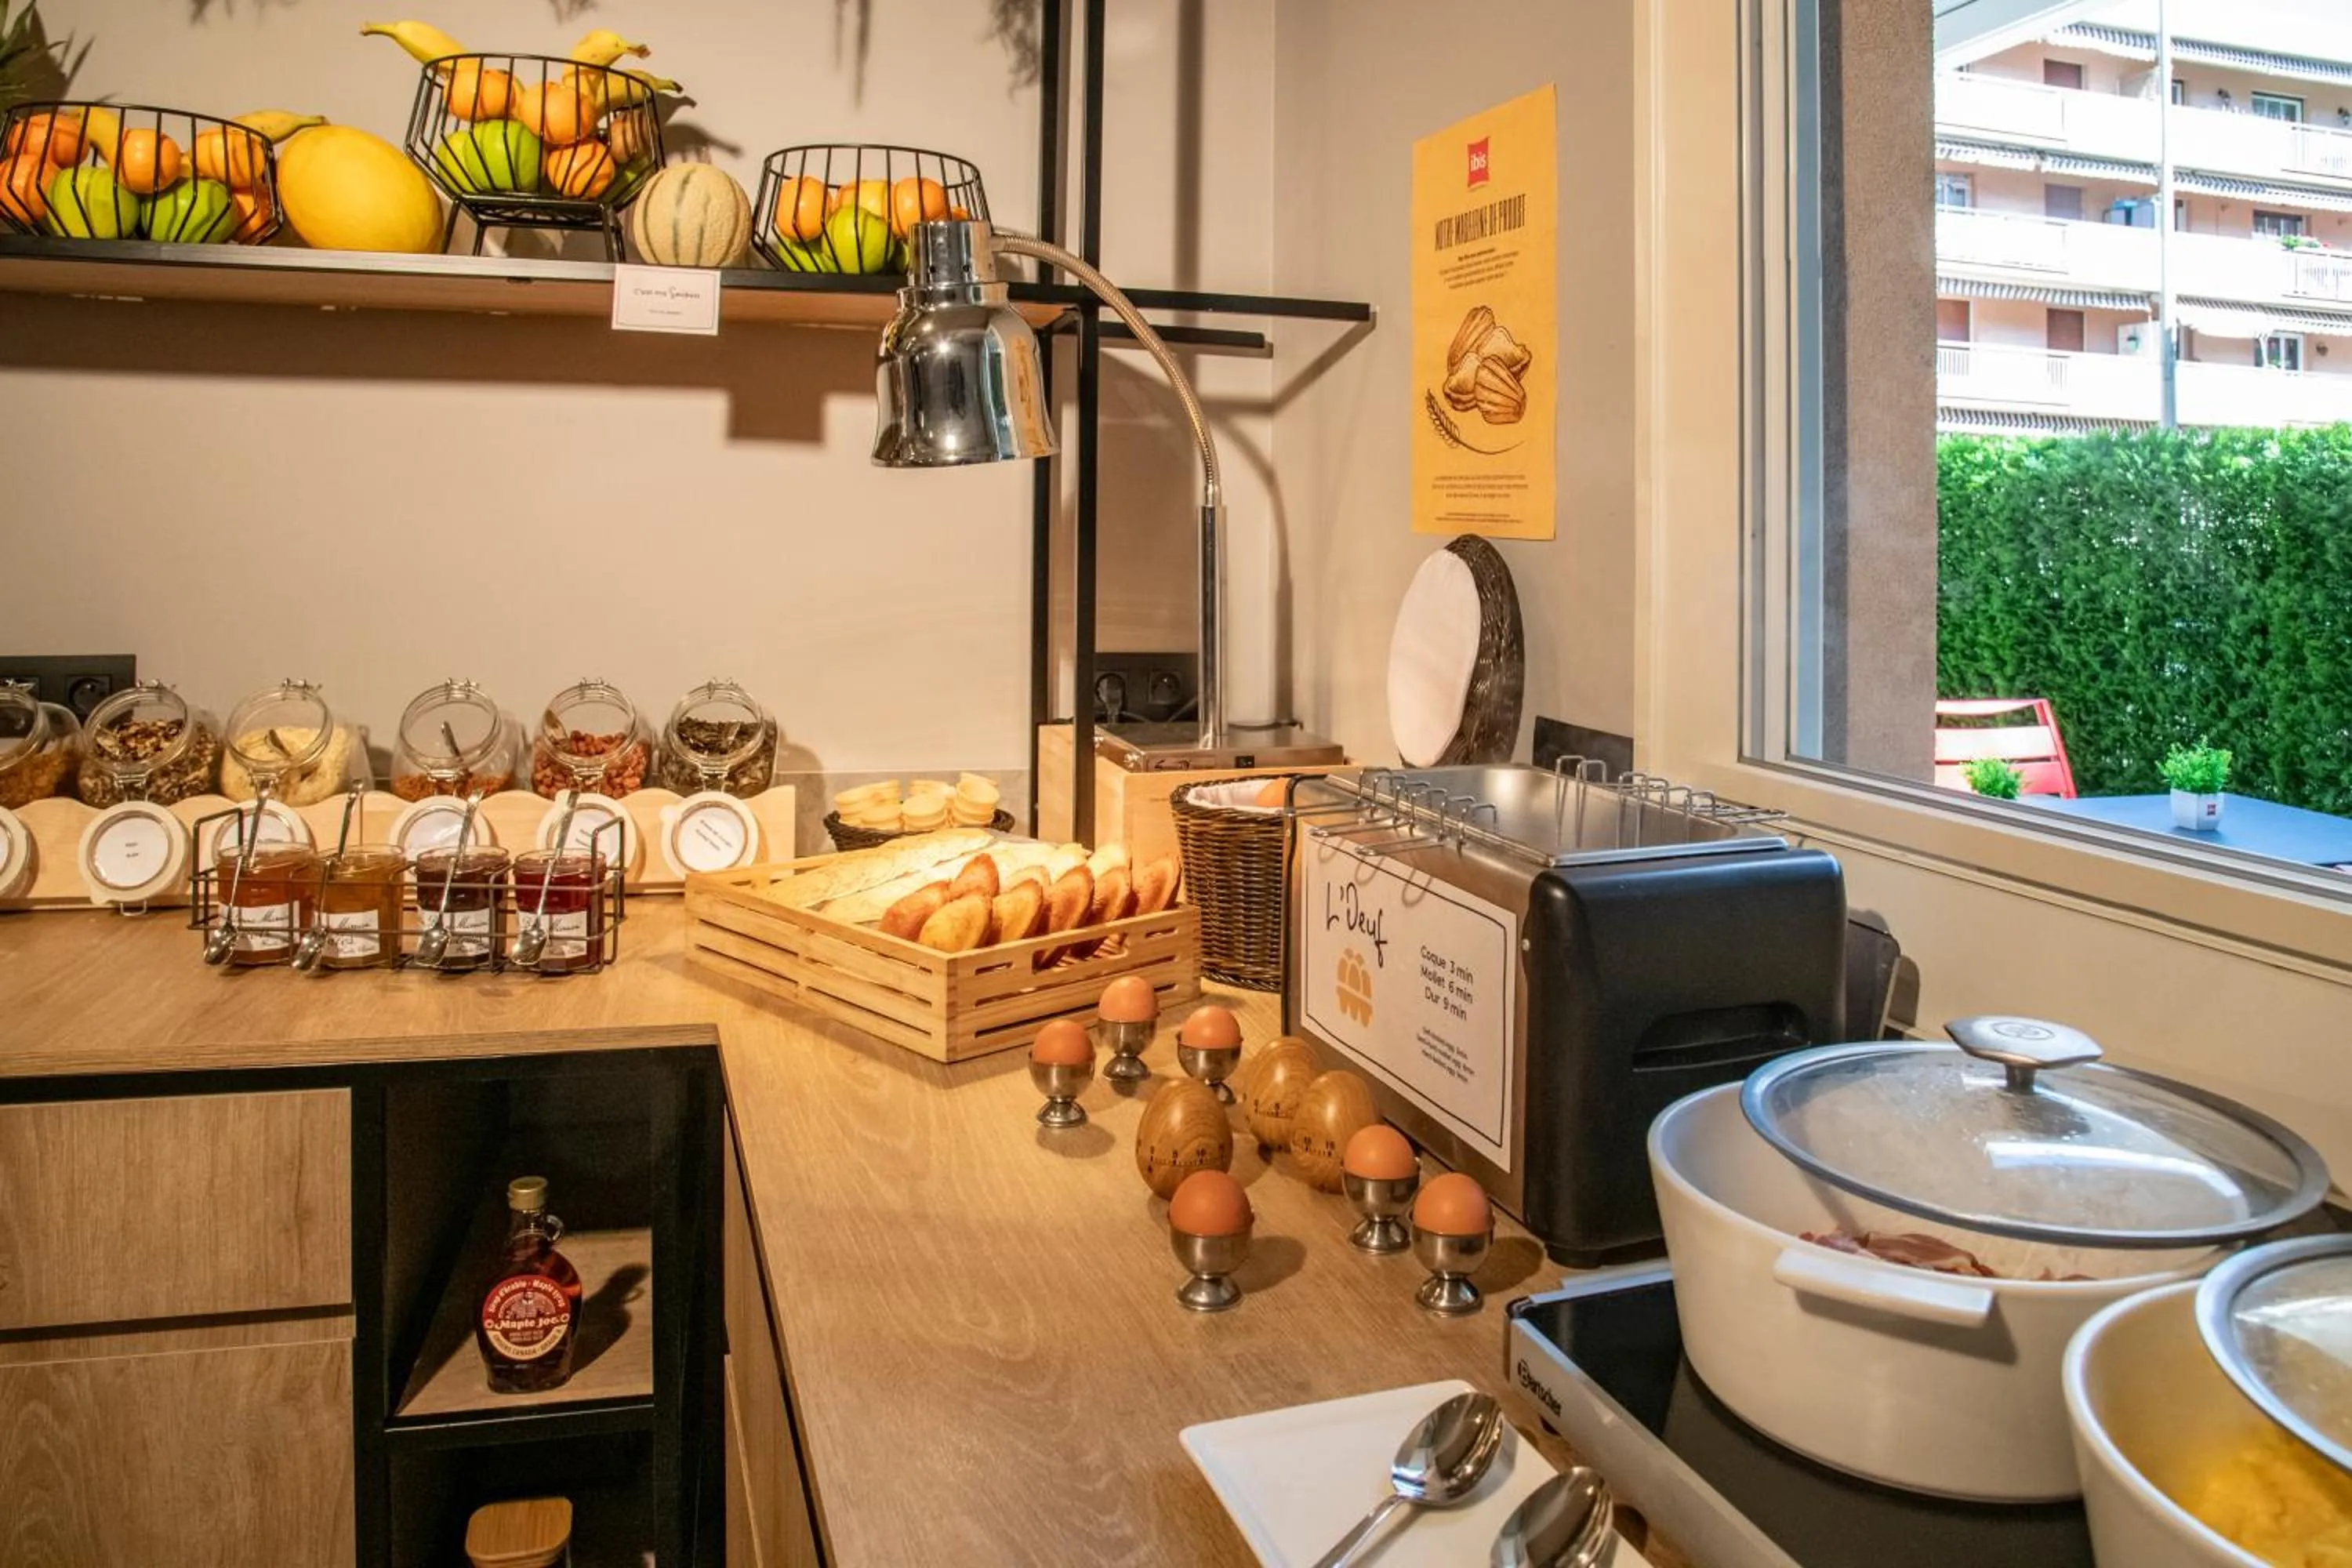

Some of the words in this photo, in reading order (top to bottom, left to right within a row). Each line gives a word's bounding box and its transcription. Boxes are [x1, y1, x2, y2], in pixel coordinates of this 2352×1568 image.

[1470, 151, 1486, 172] ibis
[1498, 193, 1525, 234] PROUST
[1420, 945, 1446, 970] Coque
[1450, 960, 1455, 974] 3
[1456, 966, 1474, 985] min
[1420, 964, 1446, 989] Mollet
[1447, 980, 1455, 993] 6
[1456, 986, 1474, 1005] min
[1425, 985, 1441, 1004] Dur
[1443, 996, 1450, 1011] 9
[1450, 1004, 1468, 1022] min
[494, 1318, 535, 1330] Maple
[536, 1316, 558, 1329] Joe
